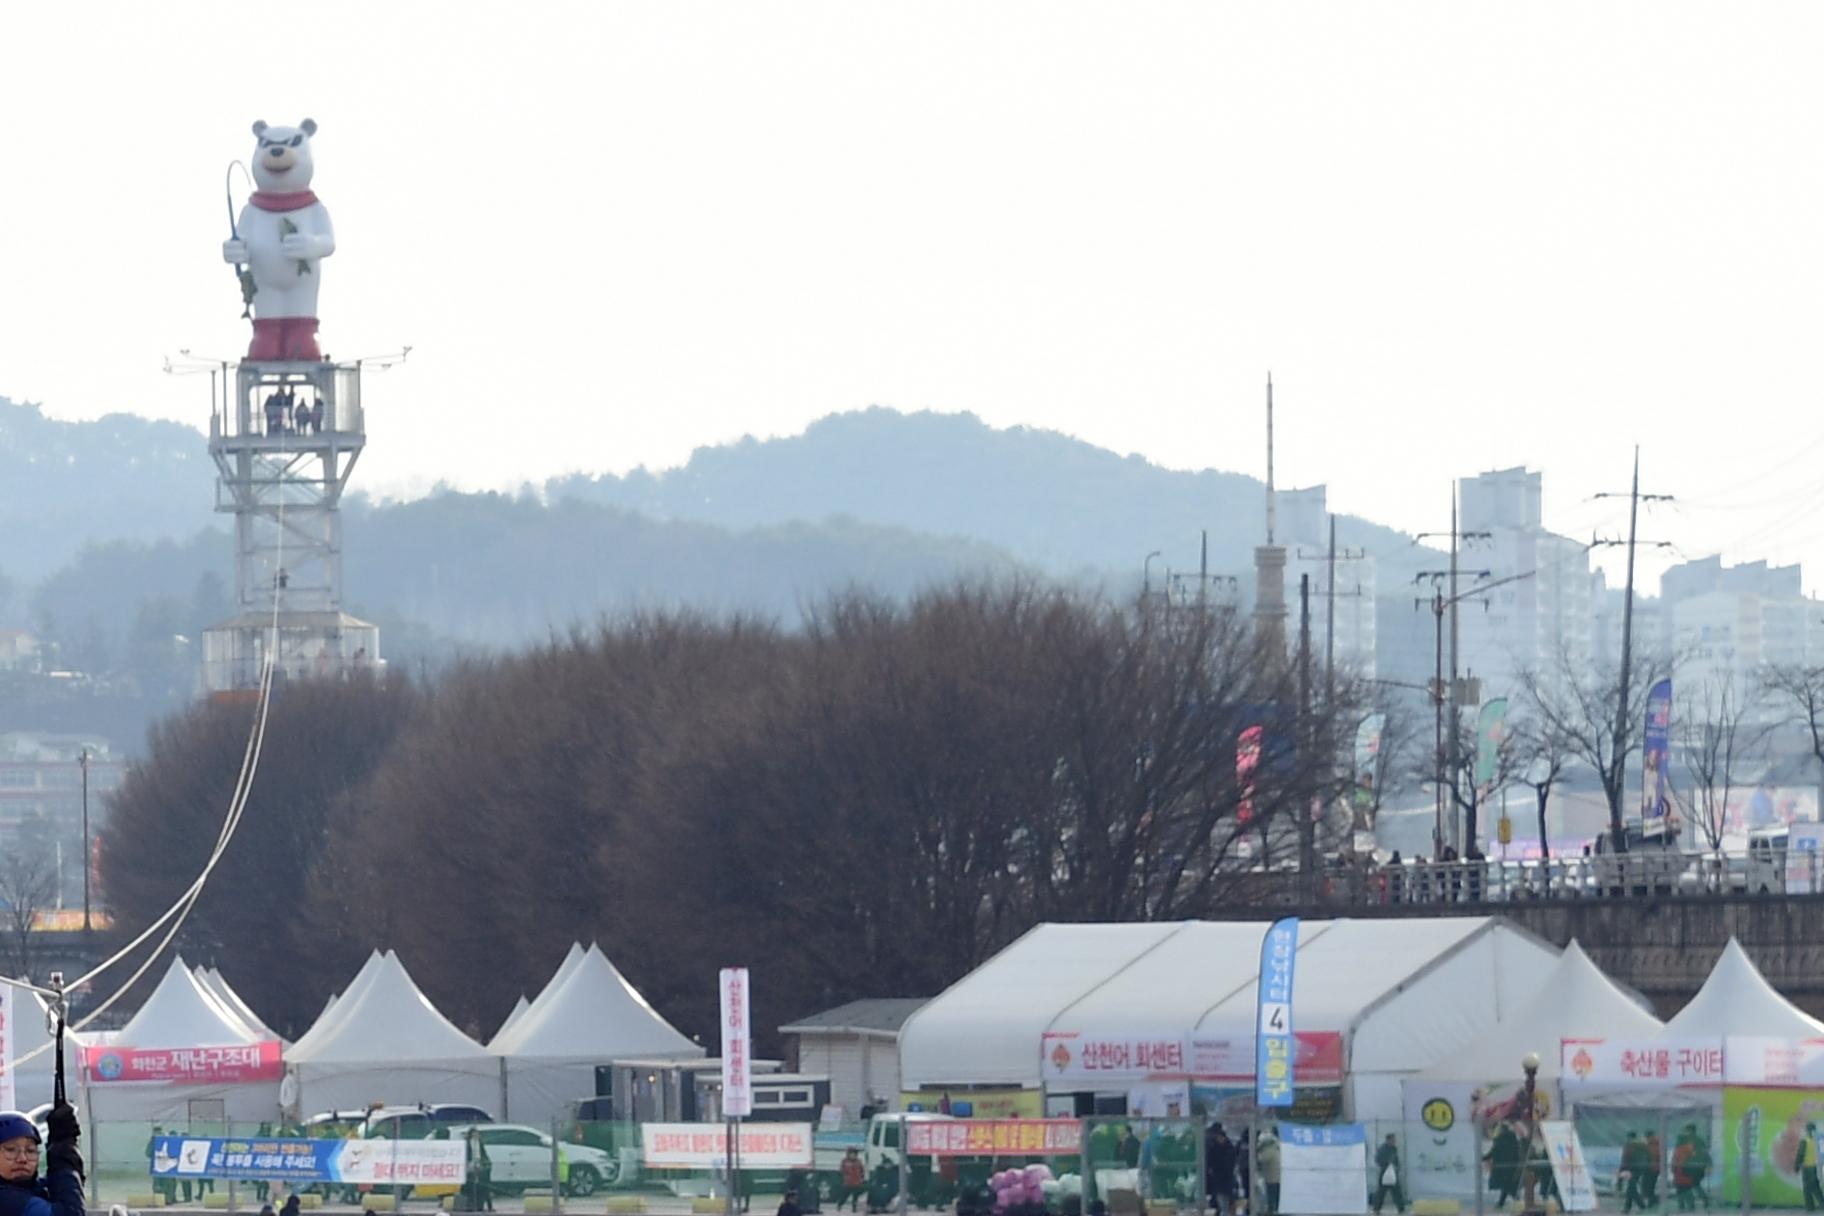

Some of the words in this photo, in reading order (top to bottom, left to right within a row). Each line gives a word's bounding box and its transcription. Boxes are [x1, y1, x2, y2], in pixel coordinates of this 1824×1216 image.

[727, 980, 743, 1027] 산천어
[1269, 1007, 1283, 1030] 4
[131, 1056, 168, 1071] 화천군
[170, 1048, 262, 1071] 재난구조대
[729, 1039, 744, 1086] 회센터
[1081, 1042, 1129, 1070] 산천어
[1135, 1042, 1183, 1070] 회센터
[1263, 1038, 1289, 1100] 입출구
[1620, 1048, 1671, 1078] 축산물
[1677, 1047, 1724, 1077] 구이터
